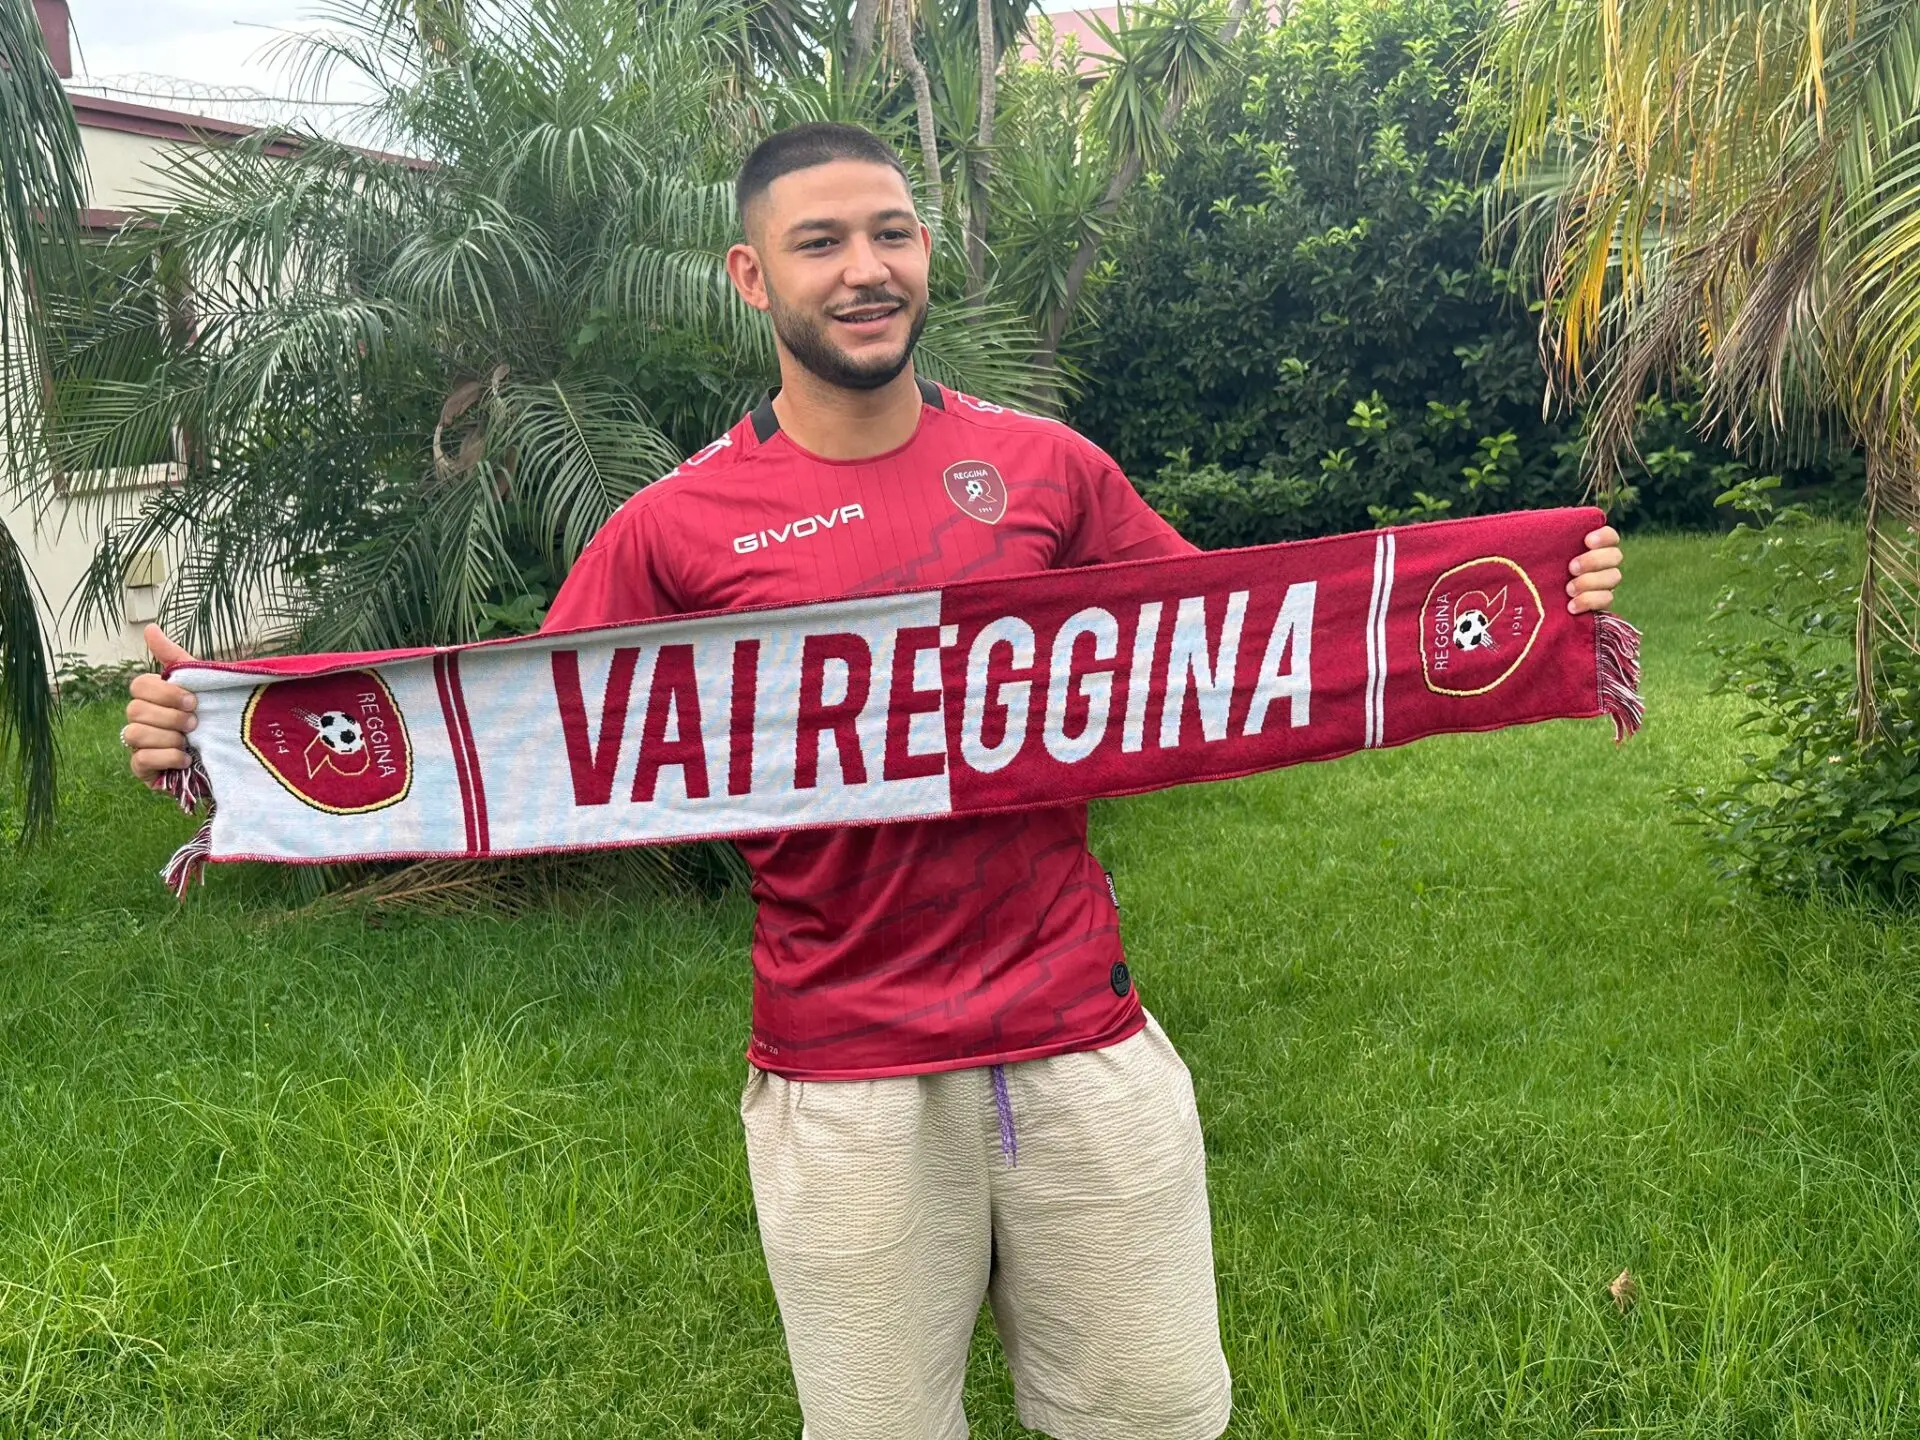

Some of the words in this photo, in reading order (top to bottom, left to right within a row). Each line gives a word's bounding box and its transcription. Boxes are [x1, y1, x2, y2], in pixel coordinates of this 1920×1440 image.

[953, 469, 988, 481] REGGINA
[733, 503, 865, 554] GIVOVA
[1434, 592, 1451, 671] REGGINA
[1511, 605, 1524, 636] 1914
[552, 639, 761, 807] VAI
[794, 580, 1318, 790] REGGINA
[267, 722, 290, 755] 1914
[356, 692, 397, 778] REGGINA
